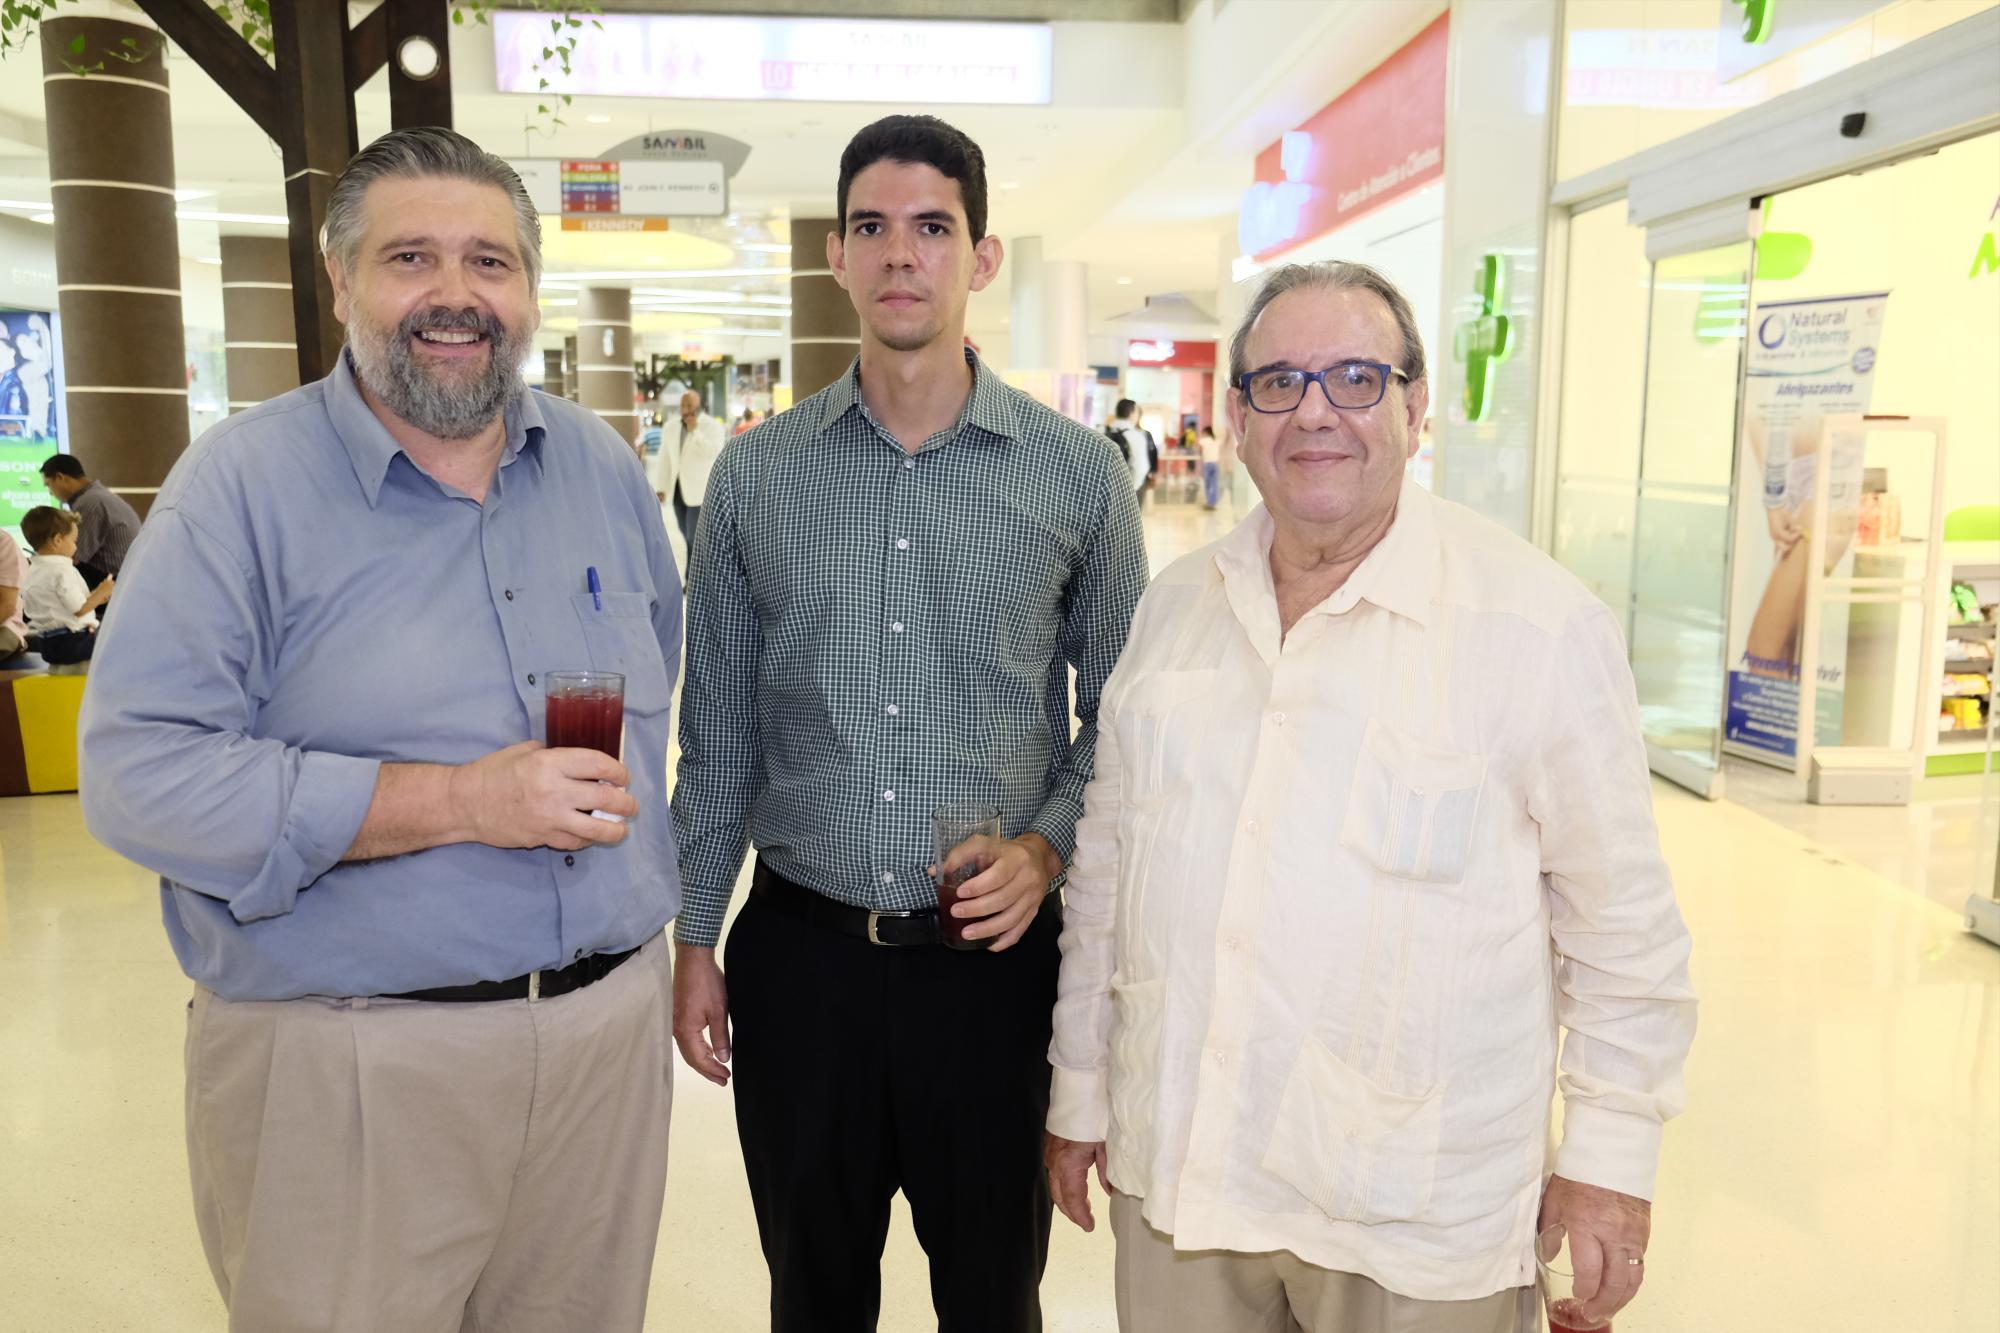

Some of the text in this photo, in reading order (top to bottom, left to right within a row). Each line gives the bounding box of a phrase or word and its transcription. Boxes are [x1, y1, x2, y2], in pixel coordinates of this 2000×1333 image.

[642, 137, 706, 150] SAMBIL
[1790, 308, 1848, 327] Natural
[1790, 329, 1851, 349] Systems
